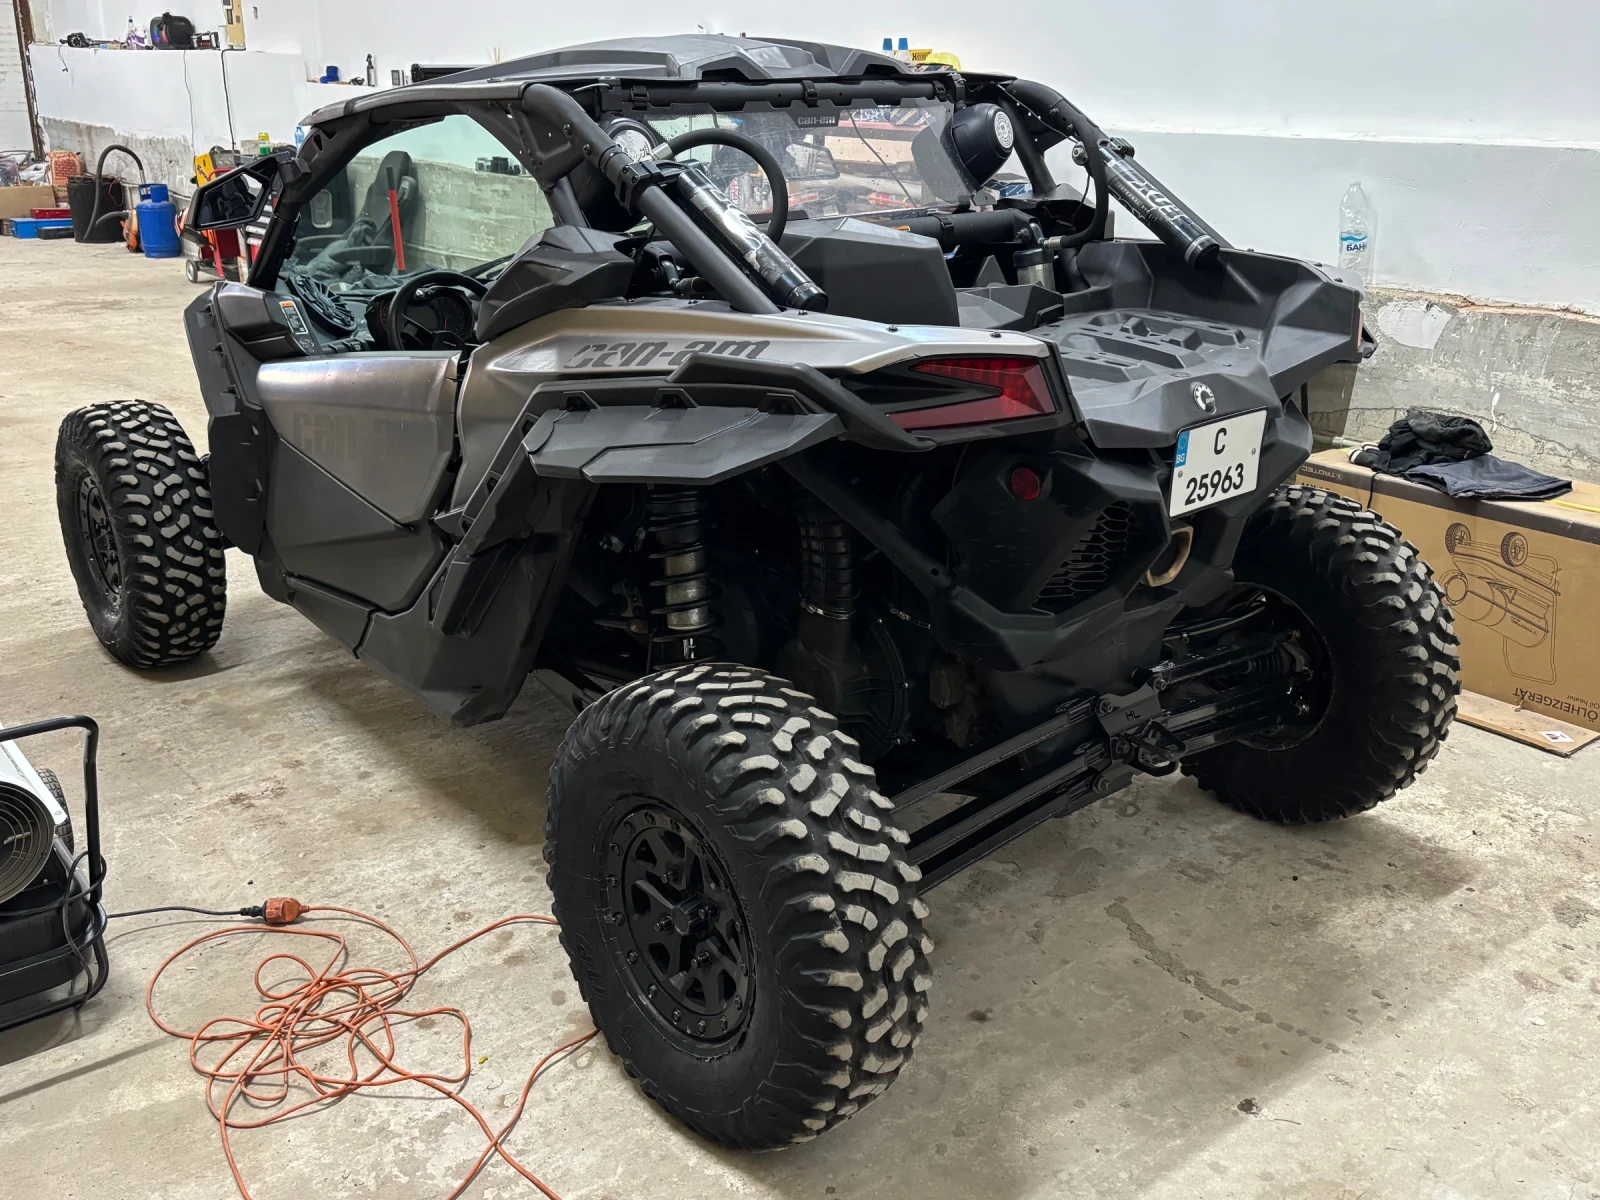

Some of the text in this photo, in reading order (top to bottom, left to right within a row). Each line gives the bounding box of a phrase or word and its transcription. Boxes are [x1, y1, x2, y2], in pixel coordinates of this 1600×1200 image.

[1175, 453, 1186, 464] BG
[1301, 465, 1336, 478] TROTEC
[1184, 462, 1244, 506] 25963
[1566, 694, 1588, 707] heater
